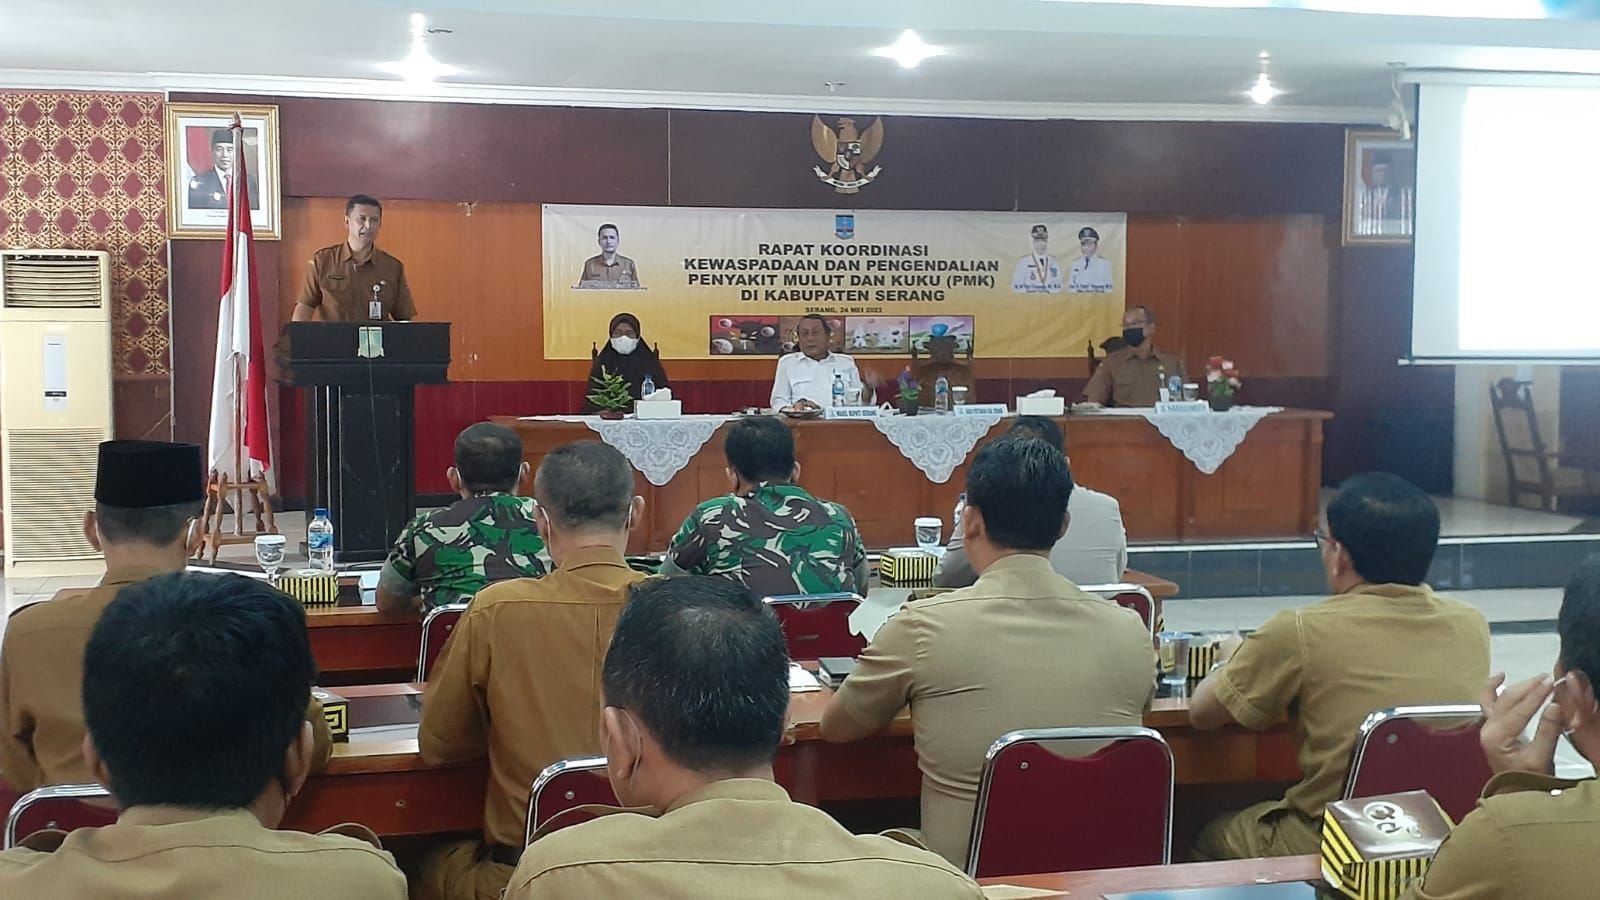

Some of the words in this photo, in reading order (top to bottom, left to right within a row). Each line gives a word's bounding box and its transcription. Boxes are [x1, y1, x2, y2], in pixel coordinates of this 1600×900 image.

[759, 243, 815, 256] RAPAT
[820, 244, 929, 257] KOORDINASI
[684, 258, 819, 271] KEWASPADAAN
[825, 259, 860, 271] DAN
[866, 260, 999, 272] PENGENDALIAN
[688, 273, 778, 286] PENYAKIT
[783, 274, 845, 286] MULUT
[850, 275, 885, 287] DAN
[891, 275, 941, 287] KUKU
[946, 275, 996, 289] (PMK)
[741, 289, 758, 301] DI
[764, 289, 869, 302] KABUPATEN
[875, 290, 945, 302] SERANG
